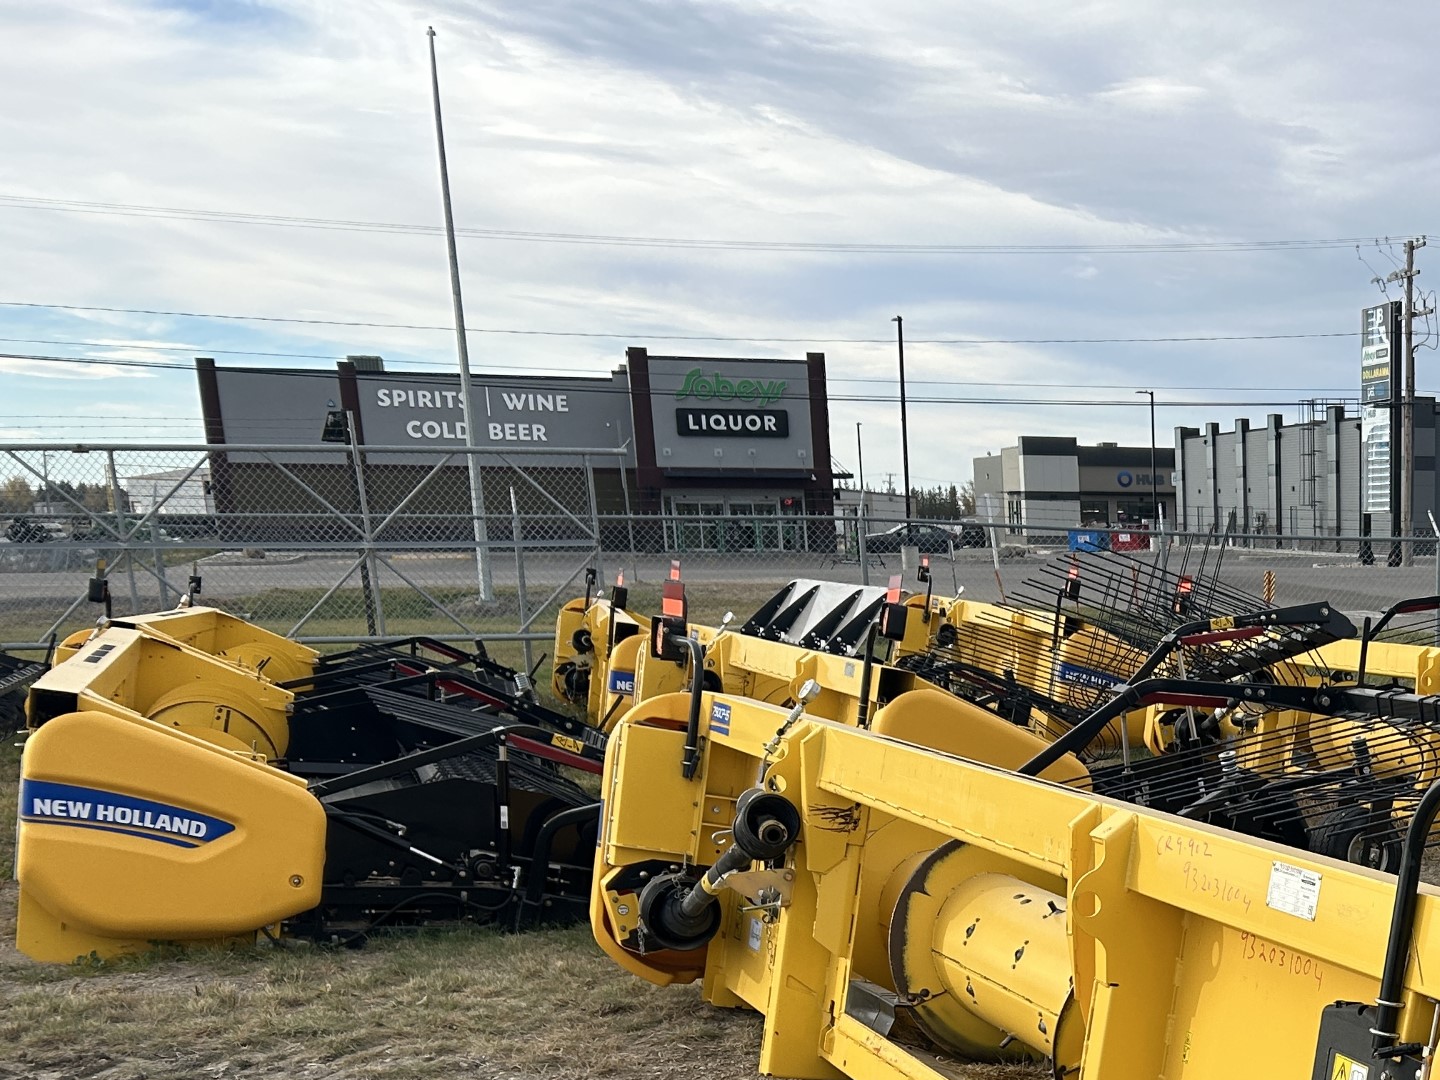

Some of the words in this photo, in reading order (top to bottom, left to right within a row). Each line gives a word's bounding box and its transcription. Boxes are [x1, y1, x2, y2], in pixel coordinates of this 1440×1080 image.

[675, 367, 787, 408] Sobeys
[502, 392, 569, 412] WINE
[406, 420, 468, 439] COLD
[488, 422, 548, 442] BEER
[688, 414, 777, 431] LIQUOR
[1136, 474, 1165, 485] HUB
[616, 680, 634, 691] NE
[33, 798, 91, 819] NEW
[96, 804, 207, 838] HOLLAND
[1240, 930, 1324, 992] 932031004
